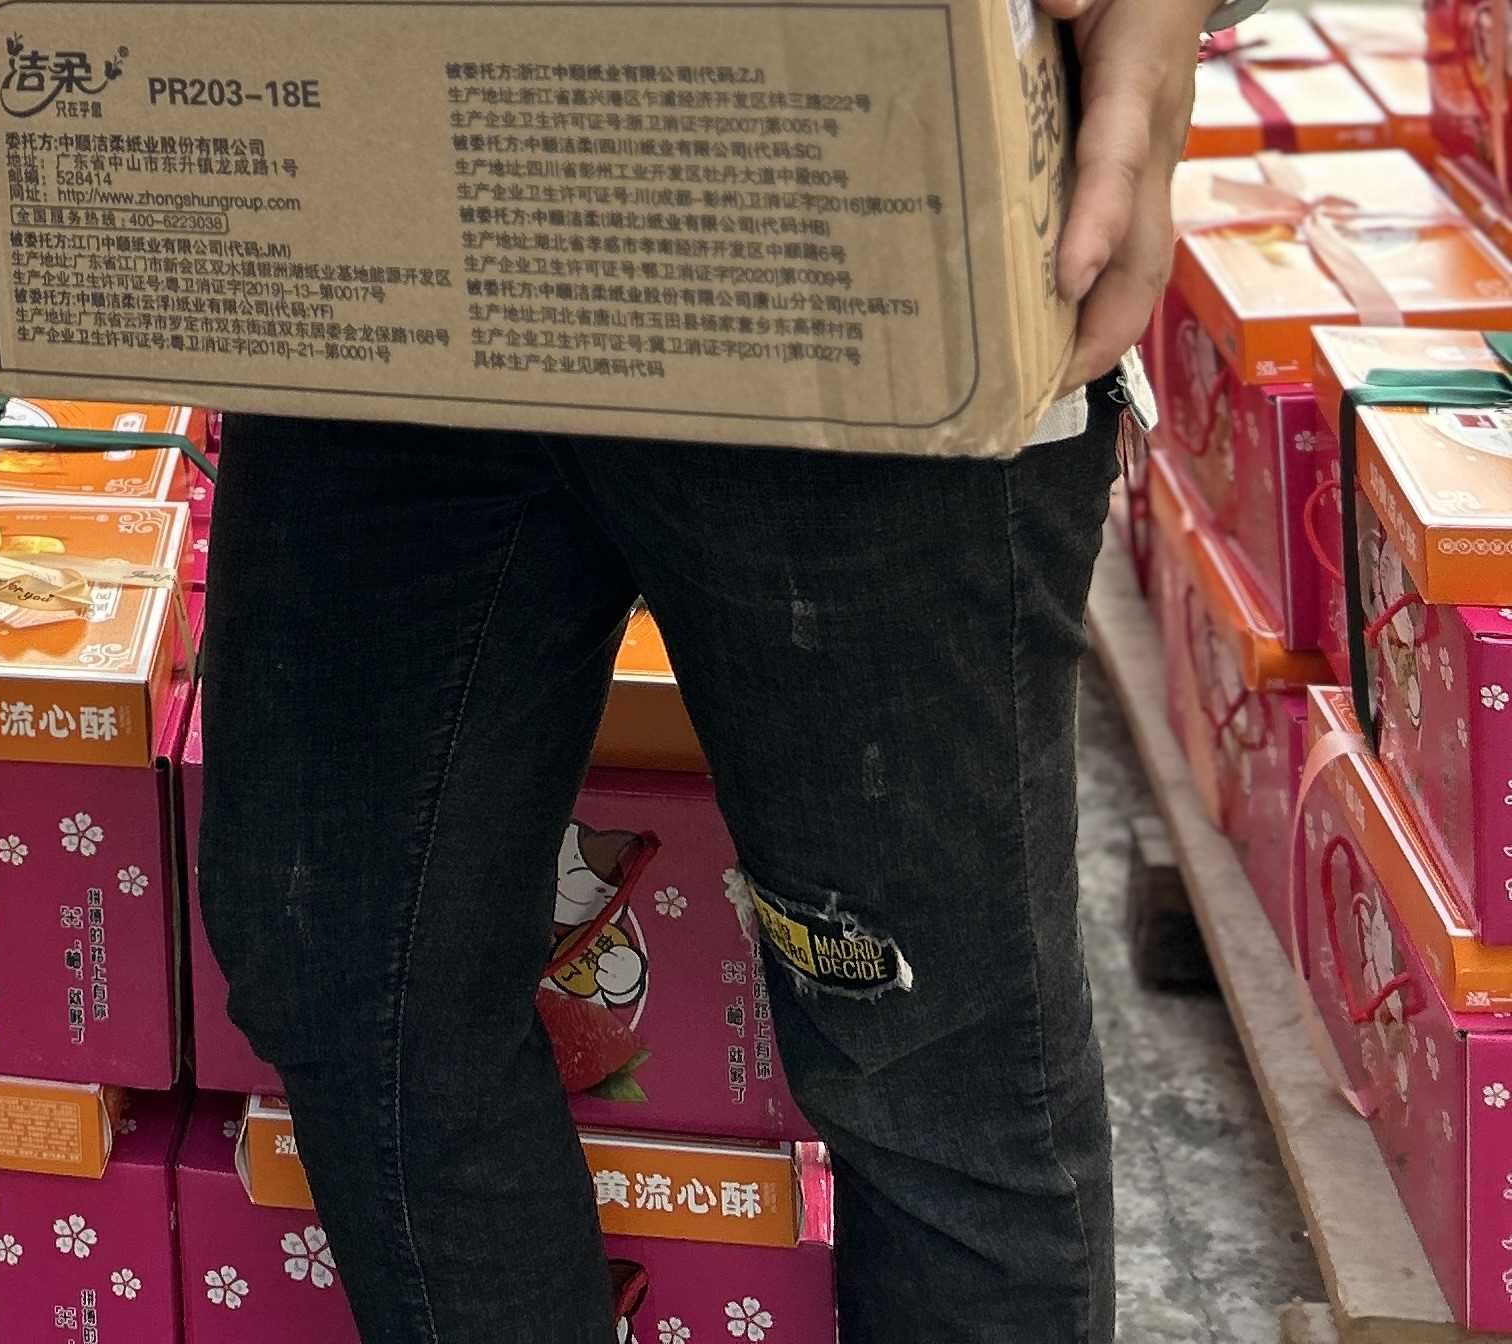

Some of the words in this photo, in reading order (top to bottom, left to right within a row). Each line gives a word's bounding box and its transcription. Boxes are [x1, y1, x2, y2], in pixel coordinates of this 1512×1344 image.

[148, 76, 321, 109] PR203-18E
[56, 169, 113, 187] 528414
[57, 186, 301, 212] http://www.zhongshungroup.com
[814, 934, 883, 960] MADRID
[817, 955, 888, 981] DECIDE
[593, 1169, 762, 1219] 黄流心酥
